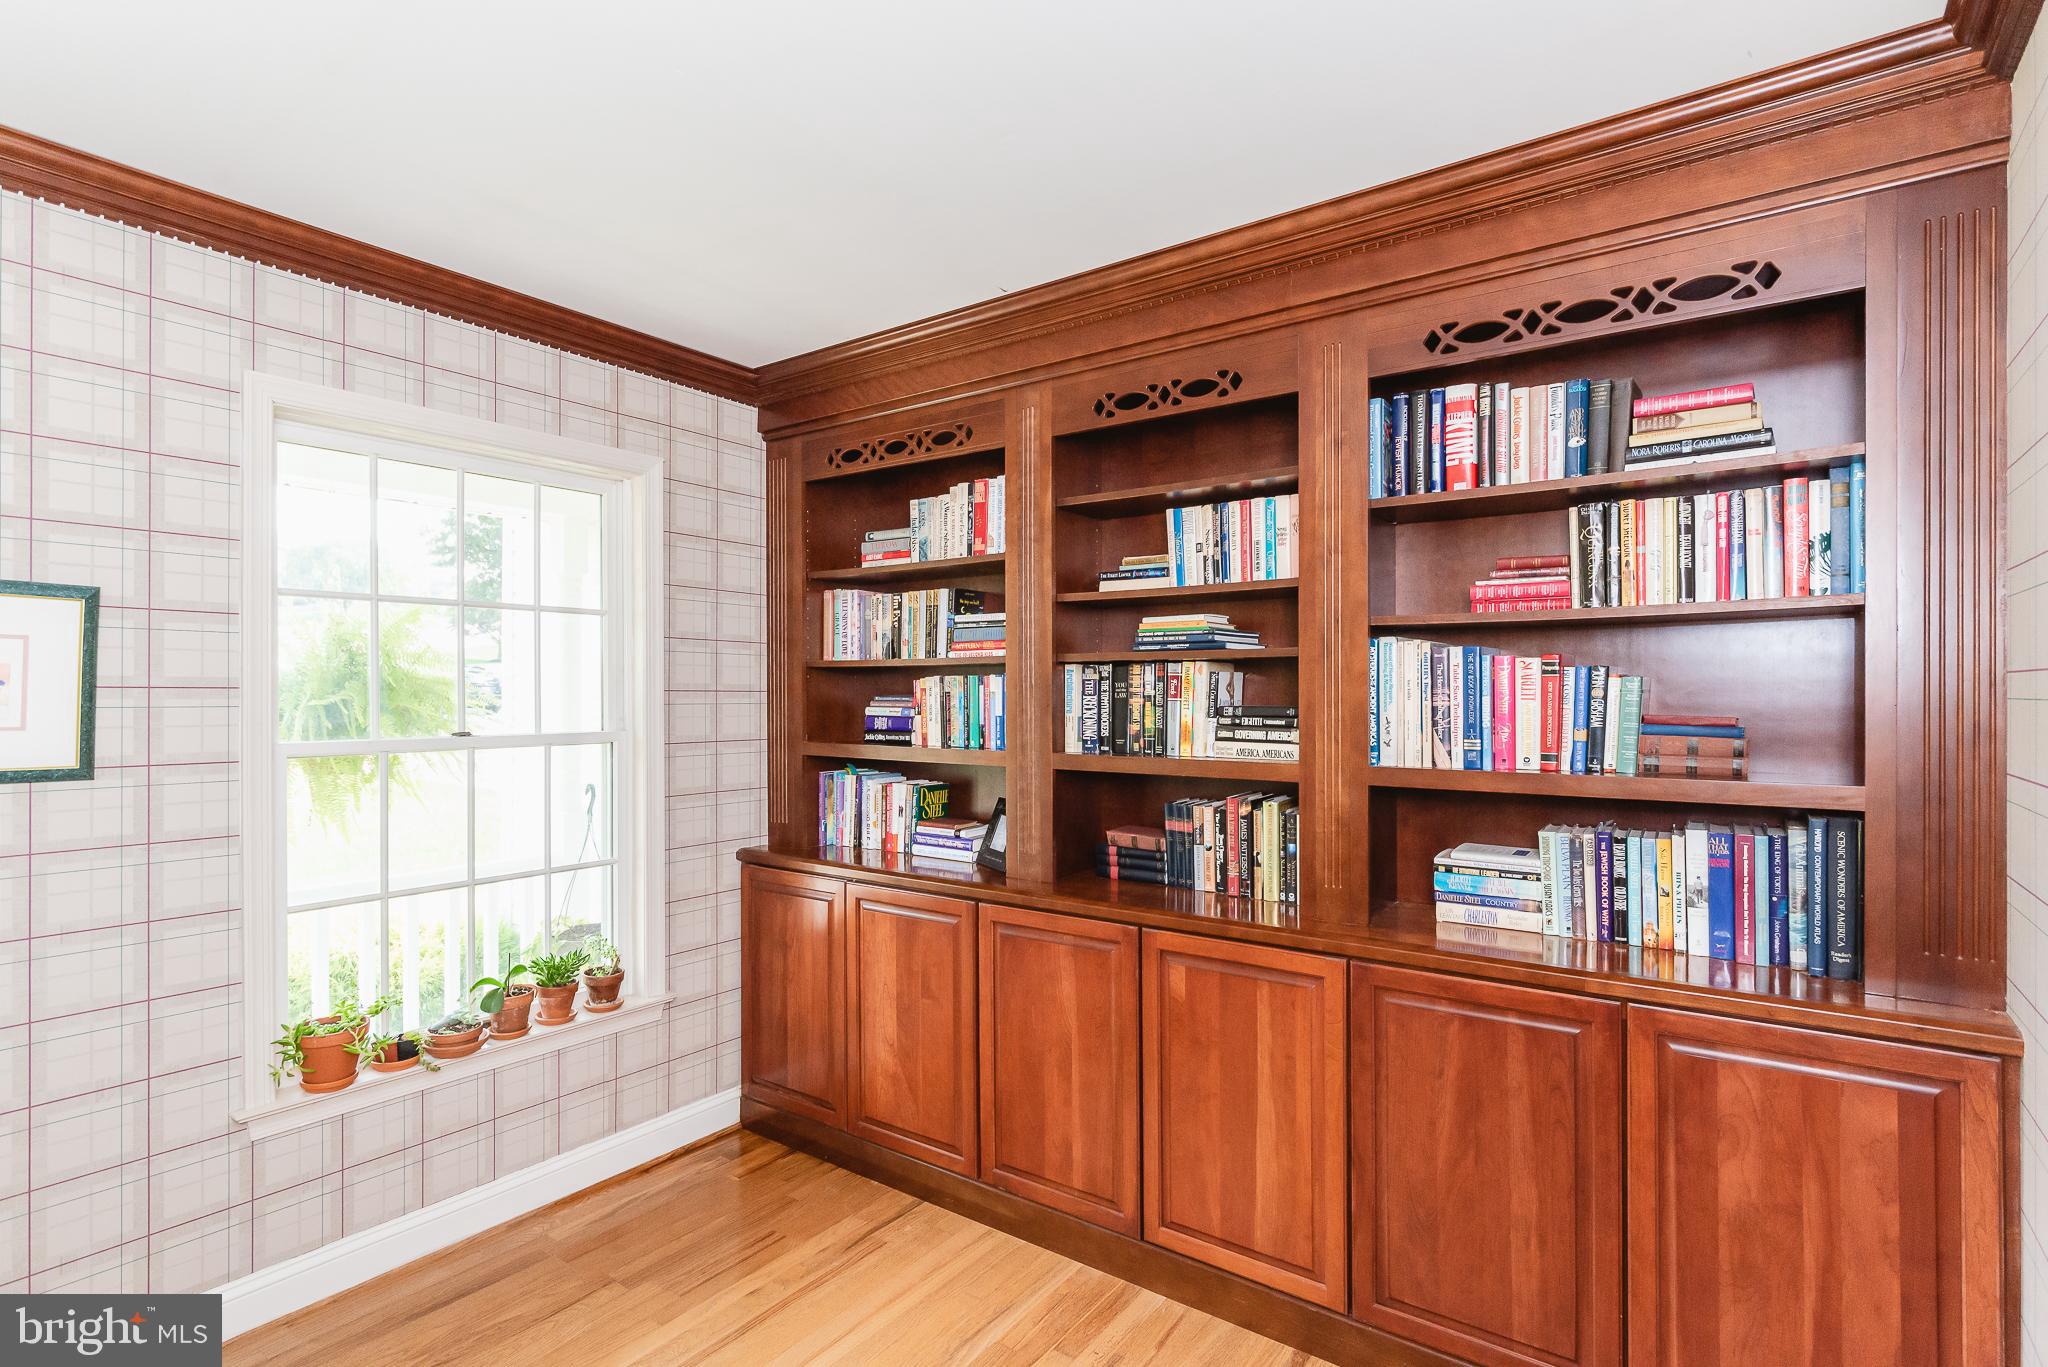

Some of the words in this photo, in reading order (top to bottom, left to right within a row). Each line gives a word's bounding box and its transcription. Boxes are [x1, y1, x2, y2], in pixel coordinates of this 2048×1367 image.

[1513, 395, 1524, 416] Jackie
[1513, 417, 1522, 439] Collins
[1446, 420, 1477, 467] KING
[1631, 447, 1651, 457] NORA
[1652, 443, 1681, 456] ROBERTS
[1692, 437, 1729, 449] CAROLINA
[1731, 433, 1755, 443] MOON
[1623, 502, 1632, 525] SIDNEY
[1623, 527, 1632, 558] SHELDON
[1580, 525, 1603, 589] QUINCUNX
[1467, 653, 1475, 663] THE
[1467, 663, 1475, 674] NEW
[1085, 680, 1094, 695] THE
[1101, 680, 1109, 692] THE
[1467, 675, 1475, 688] BOOK
[1520, 660, 1536, 701] SCARLETT
[1591, 669, 1605, 688] JOHN
[1066, 668, 1075, 714] Architecture
[1083, 695, 1098, 741] RECKONING
[1467, 696, 1475, 724] KNOWLEDGE
[1591, 698, 1605, 728] GRISHAM
[1234, 730, 1267, 740] GOVERNING
[1452, 702, 1460, 747] Techniques
[1235, 748, 1260, 757] AMERICA
[1261, 749, 1295, 759] AMERICANS
[920, 787, 949, 807] DANIELLE
[922, 802, 945, 819] STEEL
[1560, 836, 1570, 862] BELVA
[1709, 836, 1726, 844] ALL
[1837, 831, 1847, 859] SCENIC
[1562, 864, 1571, 890] PLAIN
[1774, 866, 1781, 875] OF
[1814, 855, 1822, 904] CONTEMPORARY
[1837, 859, 1847, 898] WONDERS
[1436, 892, 1463, 903] DANIELLE
[1465, 894, 1481, 905] STEEL
[1485, 898, 1518, 908] COUNTRY
[1544, 883, 1552, 899] SUSAN
[1602, 899, 1609, 908] OF
[1837, 899, 1847, 912] OF
[1814, 904, 1822, 926] WORLD
[1814, 926, 1822, 945] ATLAS
[1837, 912, 1847, 947] AMERICA
